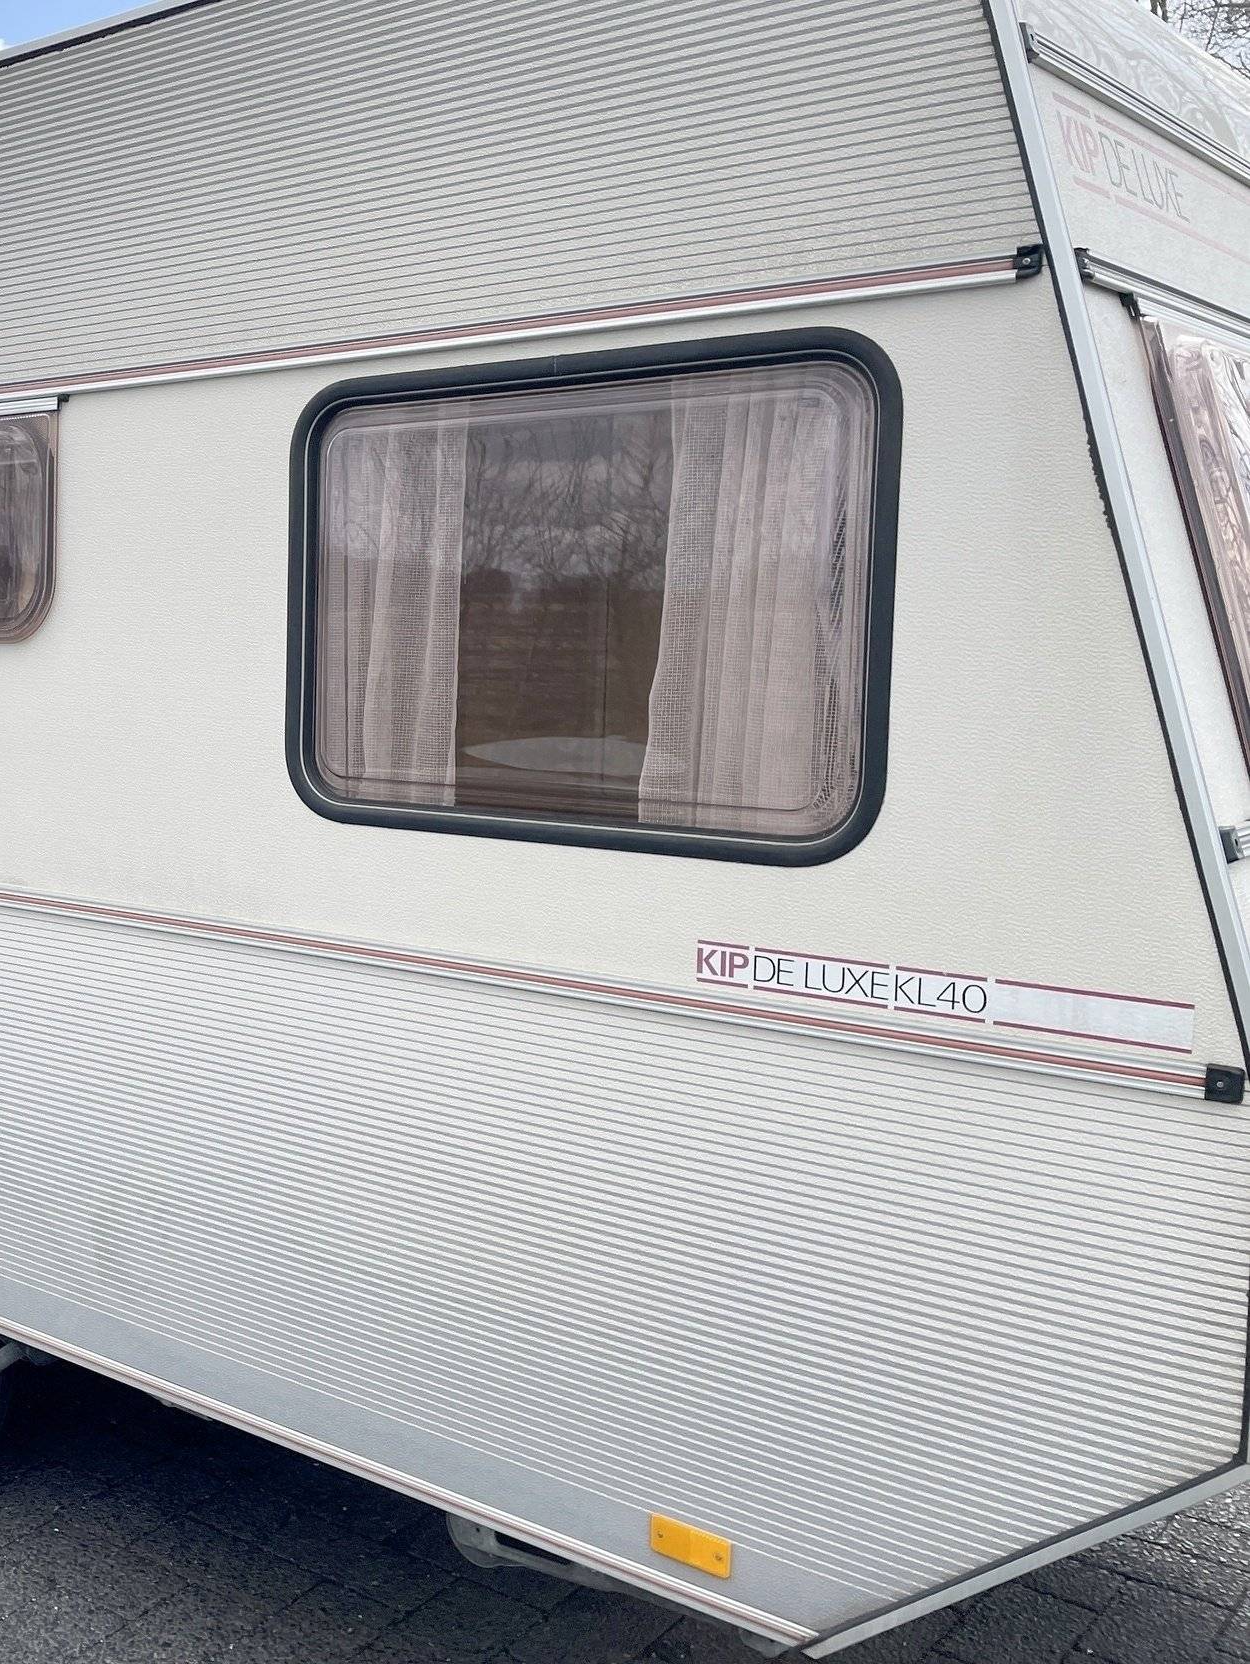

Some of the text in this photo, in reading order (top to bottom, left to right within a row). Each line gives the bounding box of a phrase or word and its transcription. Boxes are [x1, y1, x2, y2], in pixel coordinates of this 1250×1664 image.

[1056, 110, 1099, 175] KIP
[1098, 131, 1138, 197] DE
[697, 947, 750, 979] KIP
[752, 955, 795, 987] DE
[804, 962, 890, 1001] LUXE
